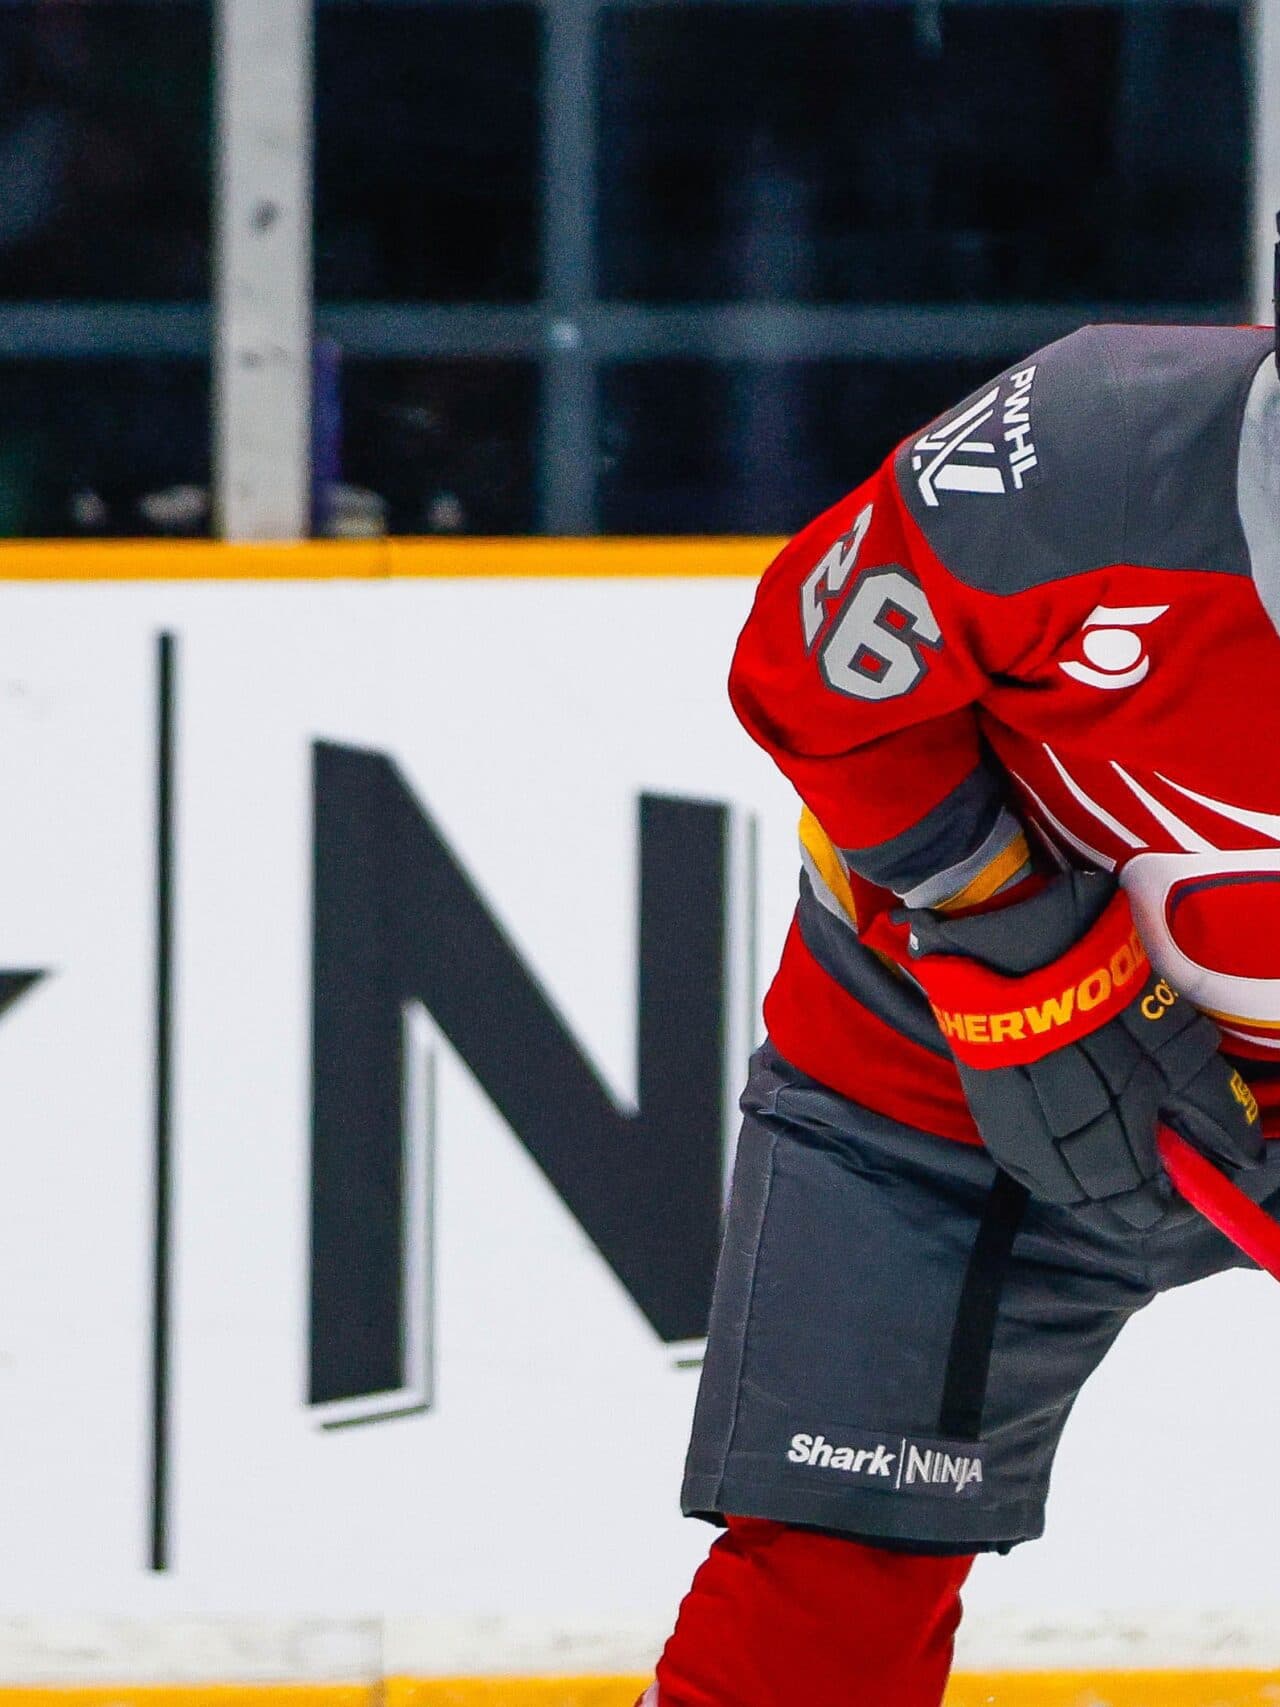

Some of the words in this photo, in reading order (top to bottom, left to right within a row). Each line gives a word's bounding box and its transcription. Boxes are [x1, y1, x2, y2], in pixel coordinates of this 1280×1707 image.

[1002, 364, 1038, 490] PWHL
[799, 502, 945, 702] 26
[787, 1433, 897, 1478] Shark
[904, 1444, 984, 1494] NINJA
